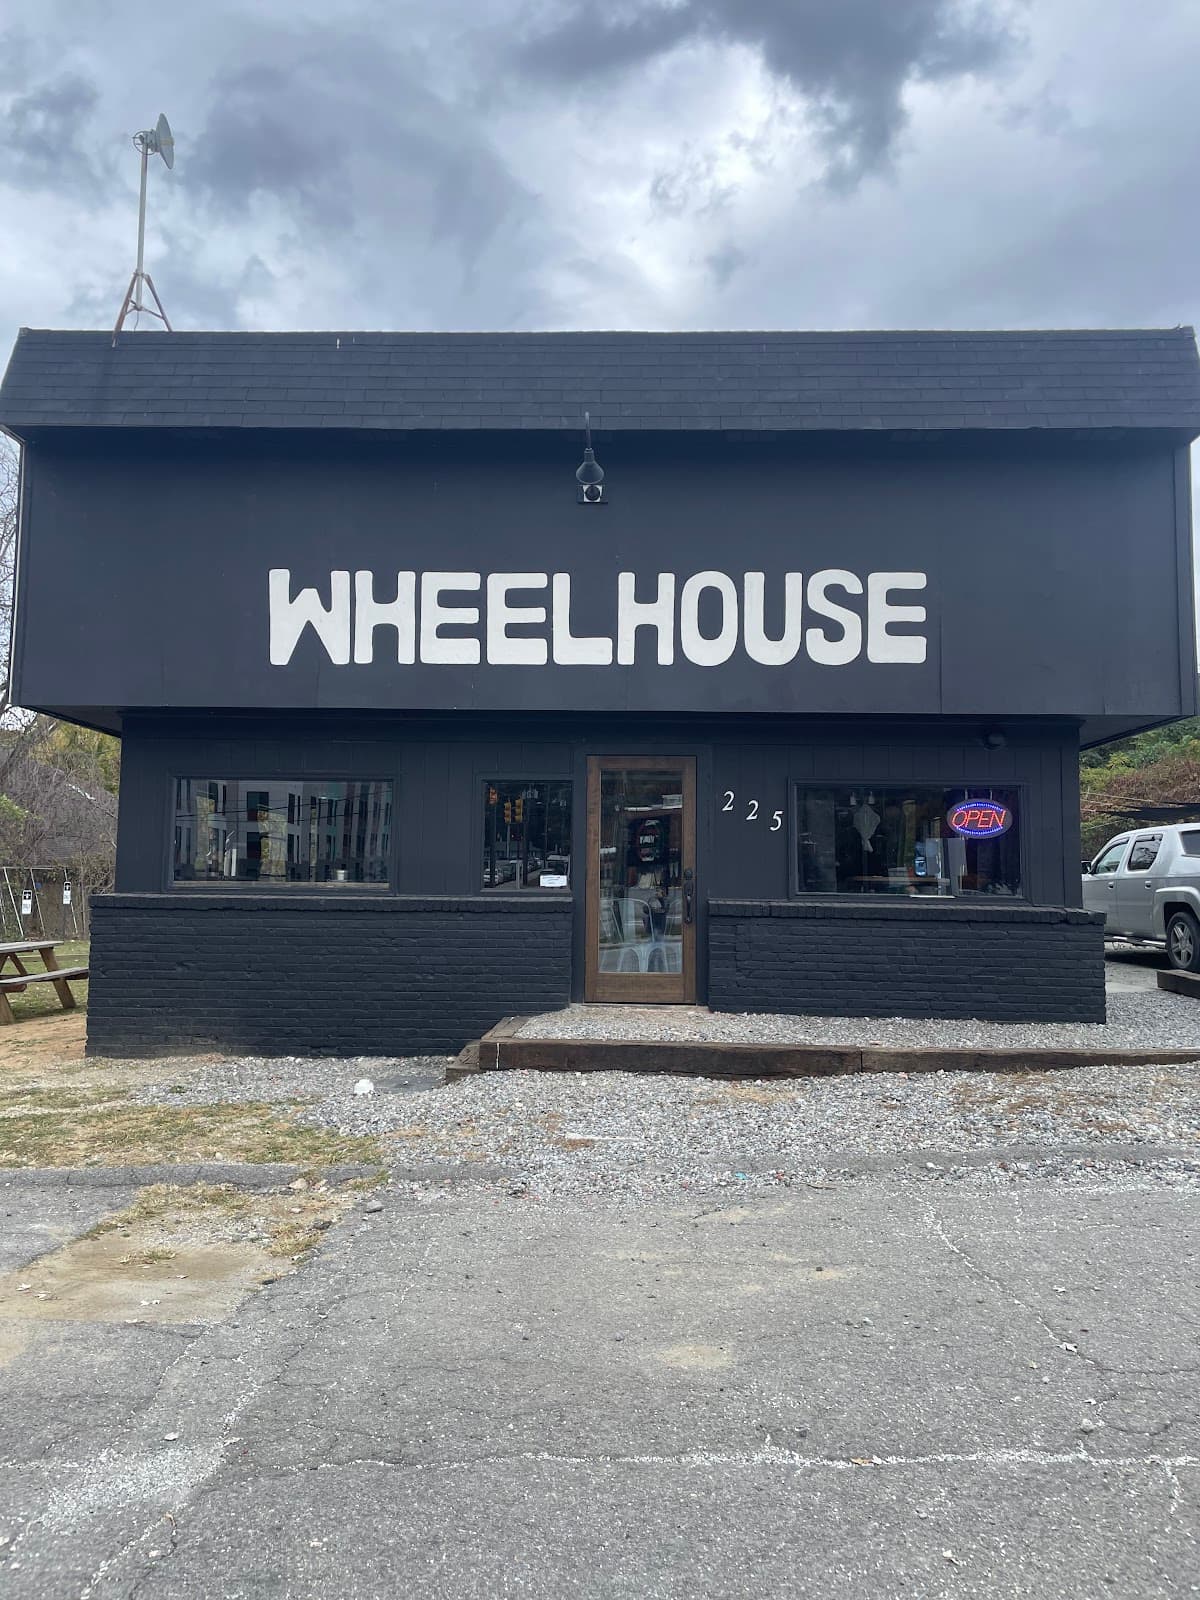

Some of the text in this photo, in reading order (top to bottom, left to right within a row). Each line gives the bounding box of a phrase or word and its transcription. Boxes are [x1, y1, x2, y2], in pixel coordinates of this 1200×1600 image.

[268, 568, 927, 666] WHEELHOUSE
[722, 790, 784, 831] 225
[951, 809, 1007, 829] OPEN
